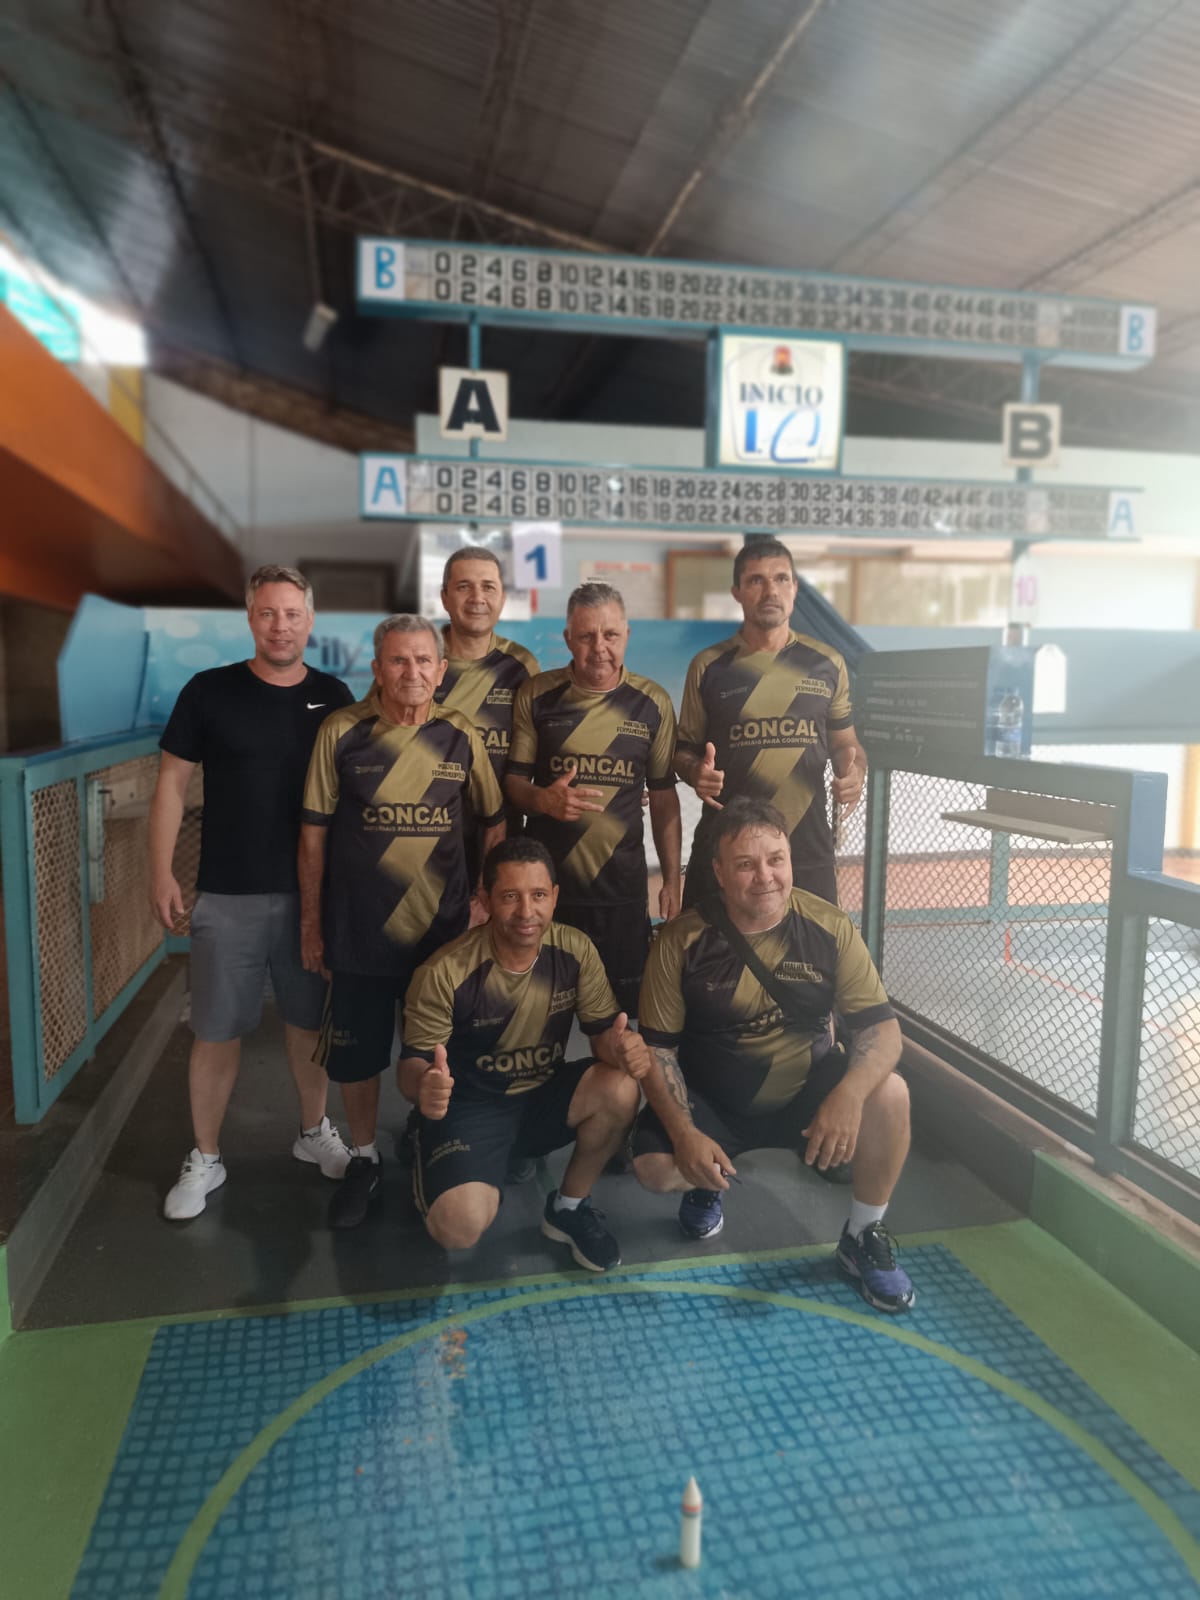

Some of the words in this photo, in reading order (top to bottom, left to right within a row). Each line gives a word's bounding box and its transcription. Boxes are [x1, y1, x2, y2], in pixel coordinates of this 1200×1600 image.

[375, 246, 395, 289] B
[435, 252, 450, 273] 0
[461, 255, 476, 276] 2
[486, 258, 502, 278] 4
[512, 260, 527, 282] 6
[537, 262, 551, 283] 8
[560, 264, 578, 284] 10
[584, 267, 602, 287] 12
[608, 269, 627, 287] 14
[633, 270, 650, 291] 16
[657, 272, 675, 292] 18
[680, 274, 699, 294] 20
[703, 275, 722, 295] 22
[727, 277, 747, 296] 24
[435, 279, 449, 300] 0
[461, 281, 475, 303] 2
[486, 285, 501, 304] 4
[512, 286, 527, 308] 6
[537, 288, 551, 309] 8
[559, 291, 577, 311] 10
[584, 292, 602, 313] 12
[608, 295, 627, 314] 14
[633, 297, 650, 316] 16
[657, 298, 674, 318] 18
[680, 300, 698, 319] 20
[703, 301, 721, 321] 22
[727, 303, 746, 322] 24
[1127, 314, 1145, 352] B
[445, 378, 502, 433] A
[1008, 411, 1053, 459] B
[371, 465, 402, 505] A
[437, 468, 452, 488] 0
[462, 469, 477, 489] 2
[486, 470, 502, 489] 4
[512, 471, 526, 491] 6
[536, 472, 550, 492] 8
[558, 474, 577, 493] 10
[582, 475, 600, 495] 12
[630, 477, 648, 496] 16
[653, 478, 670, 497] 18
[676, 479, 695, 498] 20
[700, 480, 717, 499] 22
[722, 481, 741, 499] 24
[744, 482, 763, 500] 26
[767, 482, 785, 501] 28
[790, 483, 808, 501] 30
[813, 484, 831, 501] 32
[836, 484, 853, 502] 34
[858, 486, 874, 503] 36
[437, 493, 452, 513] 0
[462, 494, 477, 514] 2
[486, 496, 501, 515] 4
[512, 497, 526, 516] 6
[536, 497, 550, 516] 8
[558, 499, 576, 517] 10
[582, 501, 600, 521] 12
[607, 502, 624, 521] 14
[630, 502, 648, 521] 16
[654, 502, 670, 521] 18
[676, 504, 695, 522] 20
[700, 504, 717, 522] 22
[722, 505, 740, 523] 24
[744, 506, 763, 524] 26
[767, 506, 785, 524] 28
[790, 507, 808, 525] 30
[813, 507, 831, 525] 32
[836, 508, 853, 526] 34
[858, 509, 874, 527] 36
[1111, 497, 1136, 535] A
[526, 545, 547, 580] 1
[729, 719, 818, 740] CONCAL
[550, 755, 635, 777] CONCAL
[362, 805, 453, 825] CONCAL
